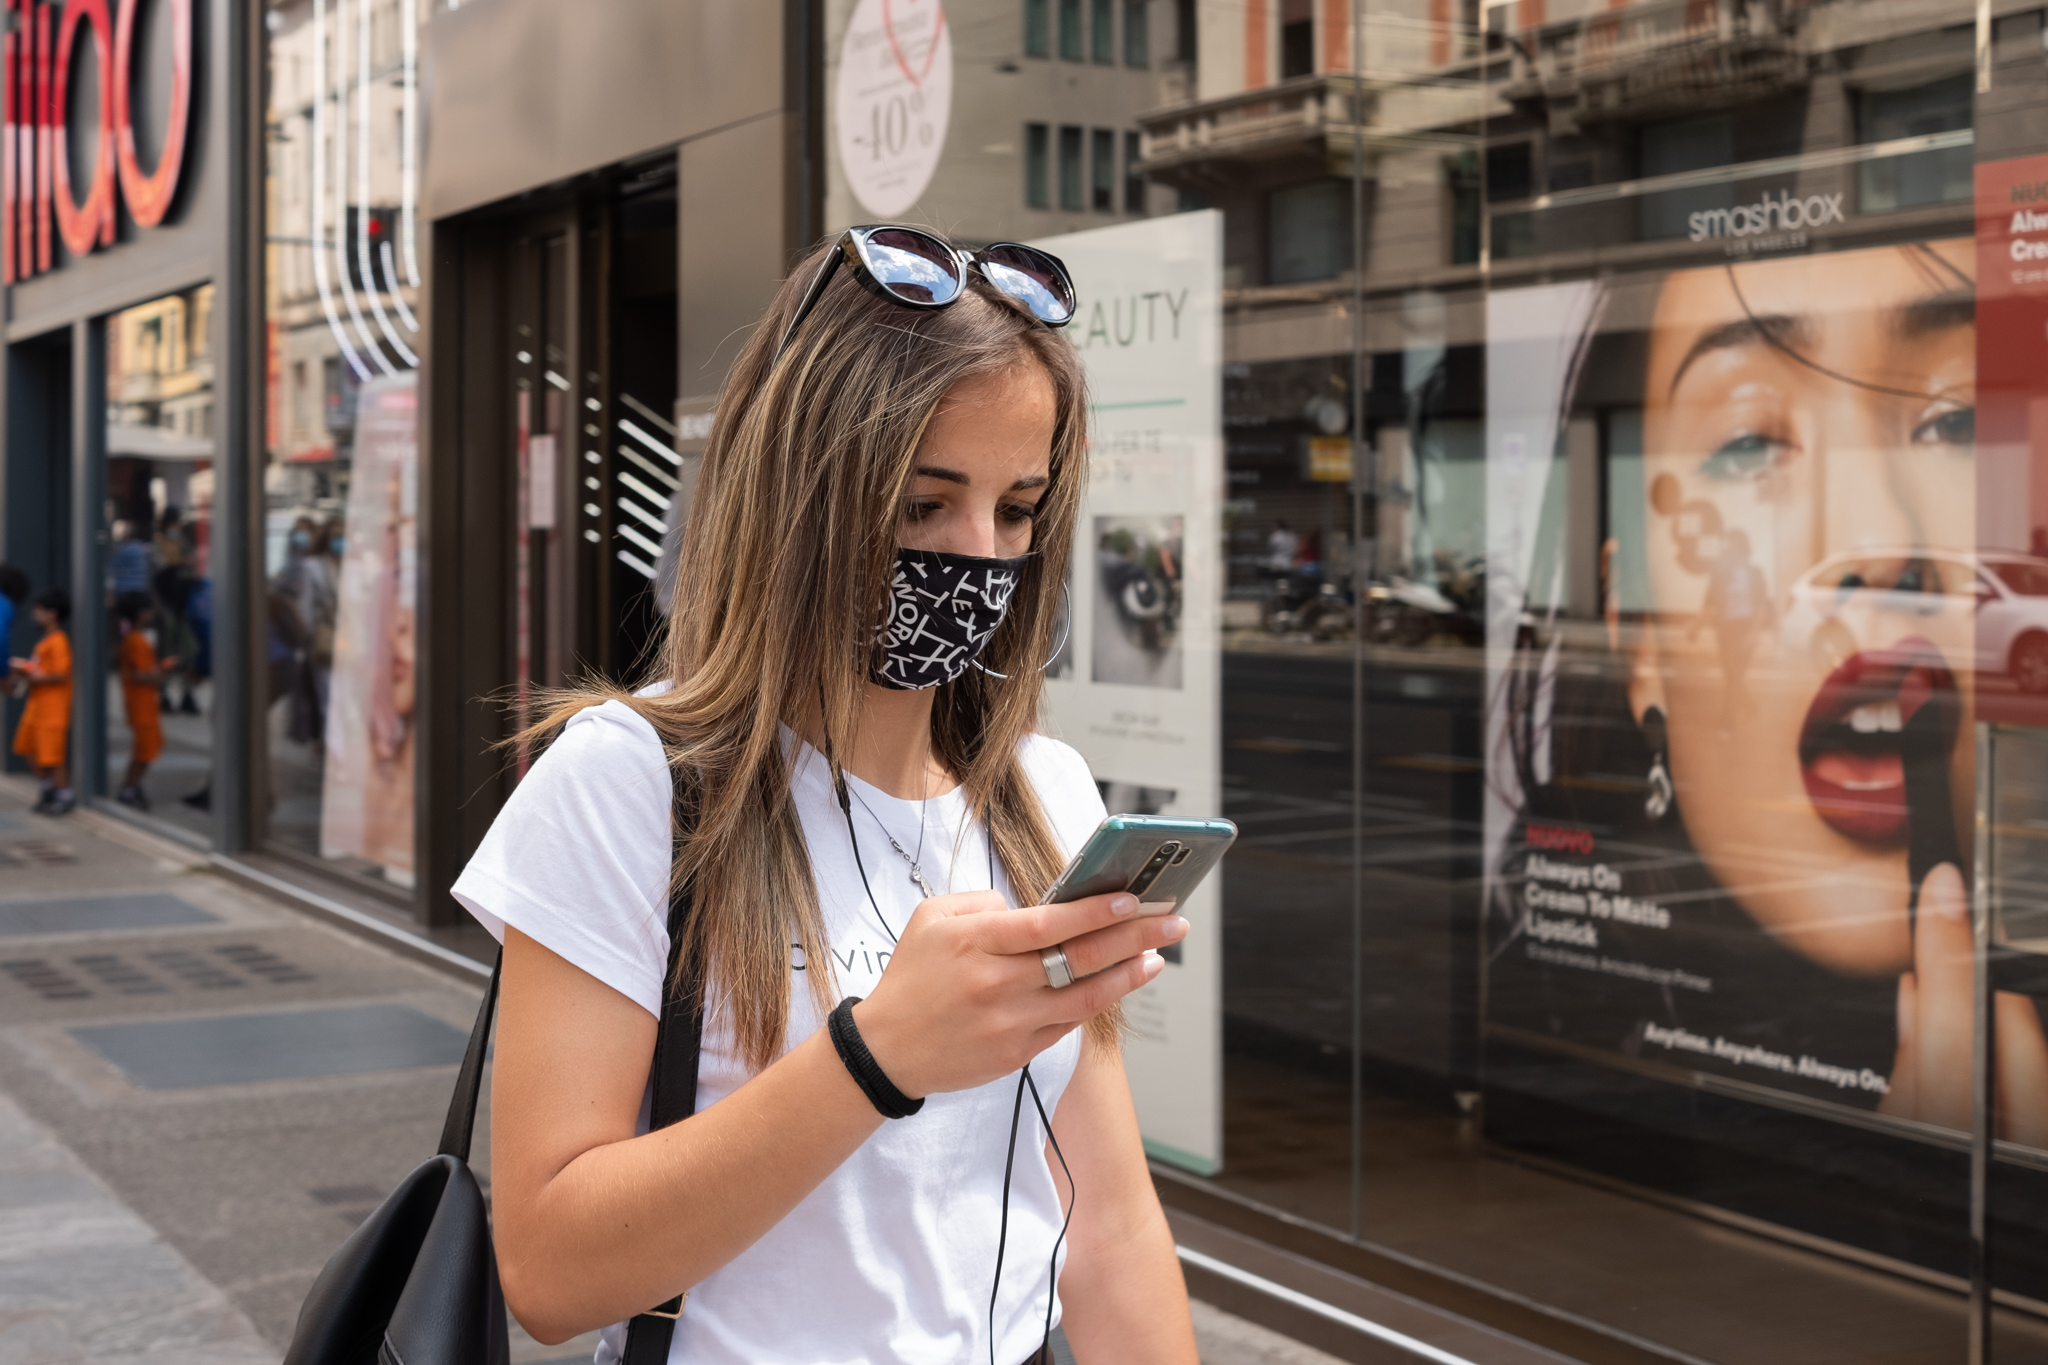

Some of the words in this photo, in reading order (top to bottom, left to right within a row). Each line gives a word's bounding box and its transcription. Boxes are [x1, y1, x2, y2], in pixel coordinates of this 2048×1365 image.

[1688, 188, 1844, 242] smashbox
[2010, 238, 2048, 262] Cre
[1526, 824, 1594, 855] NUOVO
[1527, 853, 1592, 890] Always
[1592, 863, 1621, 892] On
[1525, 882, 1588, 914] Cream
[1588, 891, 1612, 919] To
[1612, 895, 1671, 930] Matte
[1525, 910, 1598, 947] Lipstick
[1644, 1021, 1713, 1053] Anytime.
[1713, 1036, 1796, 1074] Anywhere.
[1797, 1055, 1858, 1088] Always
[1859, 1068, 1892, 1094] On.
